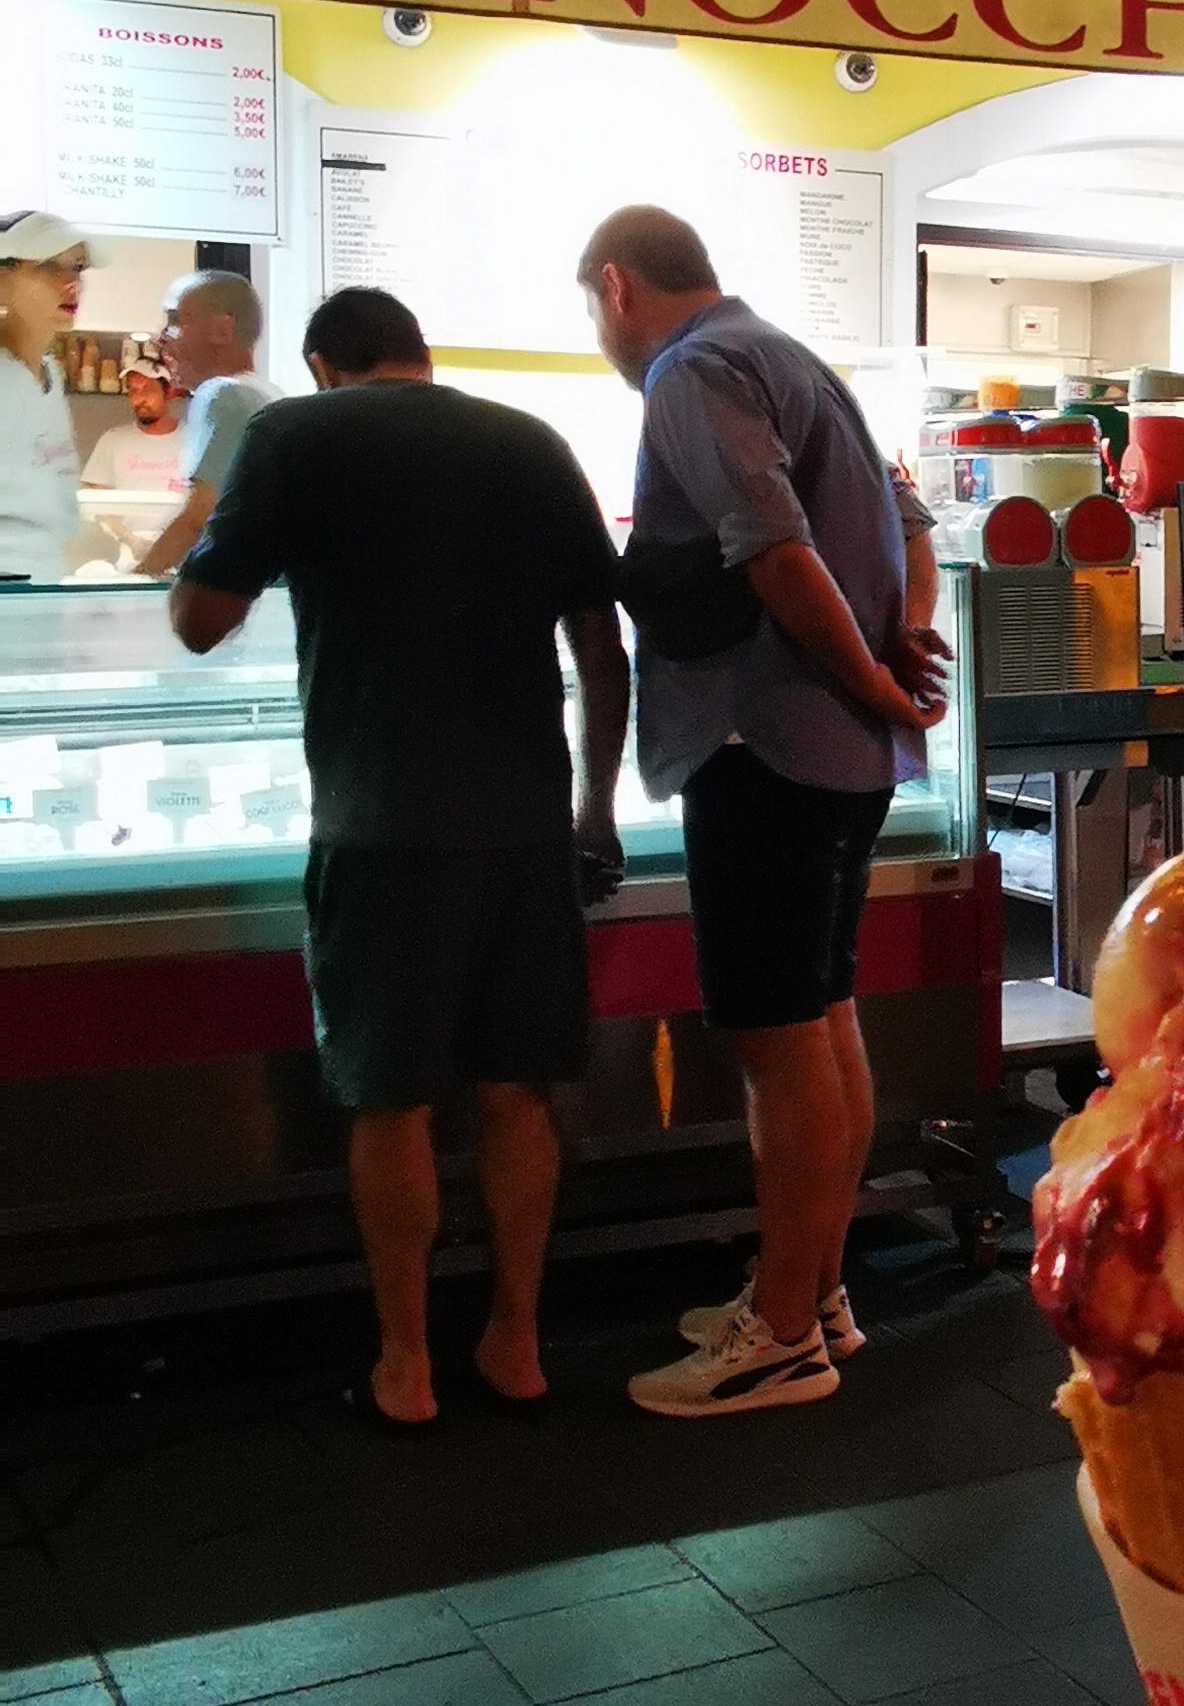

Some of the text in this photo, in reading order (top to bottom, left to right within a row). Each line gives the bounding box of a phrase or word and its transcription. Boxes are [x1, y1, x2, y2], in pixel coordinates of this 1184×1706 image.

[98, 27, 224, 50] BOISSONS
[232, 66, 266, 81] 2,00€
[60, 83, 105, 96] RANITA
[233, 96, 266, 110] 2,00€
[60, 98, 106, 111] RANITA
[233, 111, 266, 125] 3,50€
[60, 113, 106, 126] RANITA
[234, 126, 266, 140] 5,00€
[89, 155, 126, 168] SHAKE
[738, 151, 828, 177] SORBETS
[89, 173, 128, 185] SHAKE
